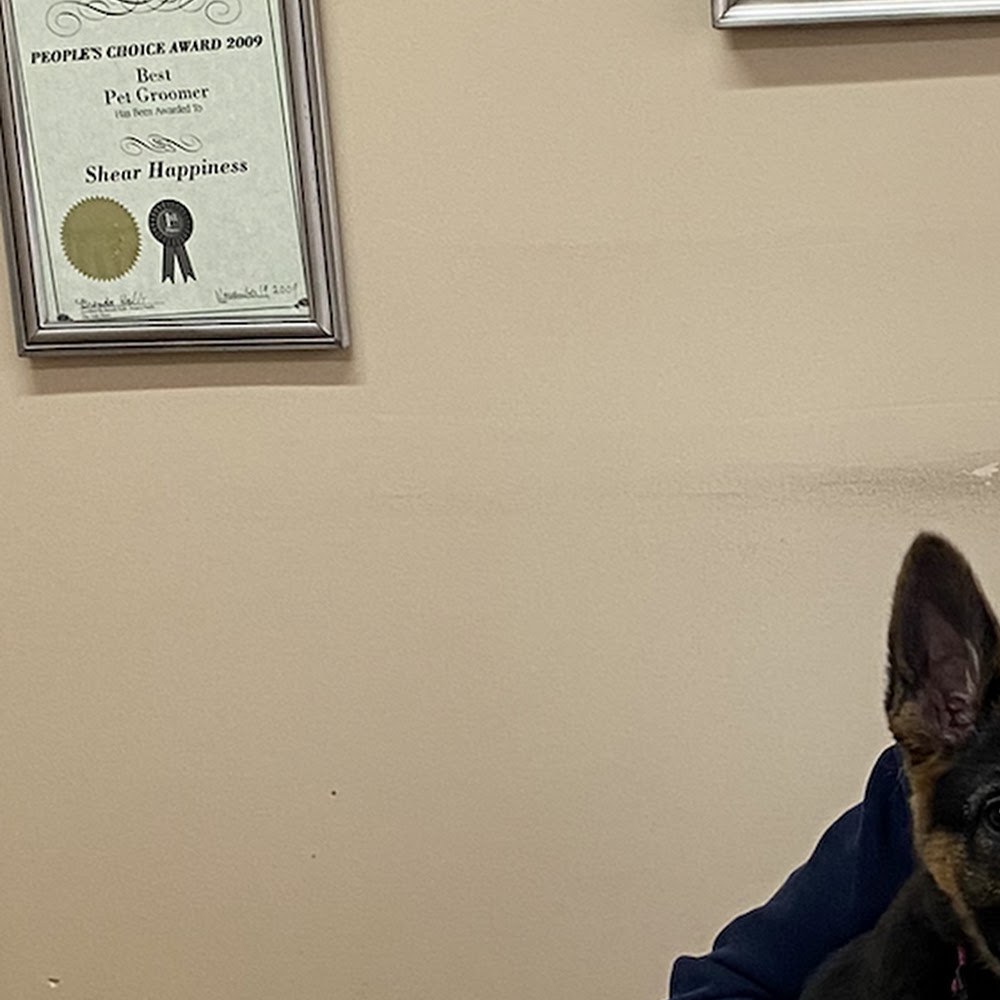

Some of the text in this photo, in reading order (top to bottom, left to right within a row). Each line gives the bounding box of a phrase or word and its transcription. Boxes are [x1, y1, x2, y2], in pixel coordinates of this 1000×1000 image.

[30, 35, 263, 64] PEOPLE'S CHOICE AWARD 2009
[136, 67, 171, 83] Best
[104, 86, 209, 105] Pet Groomer
[155, 104, 191, 115] Awarded
[85, 158, 249, 184] Shear Happiness
